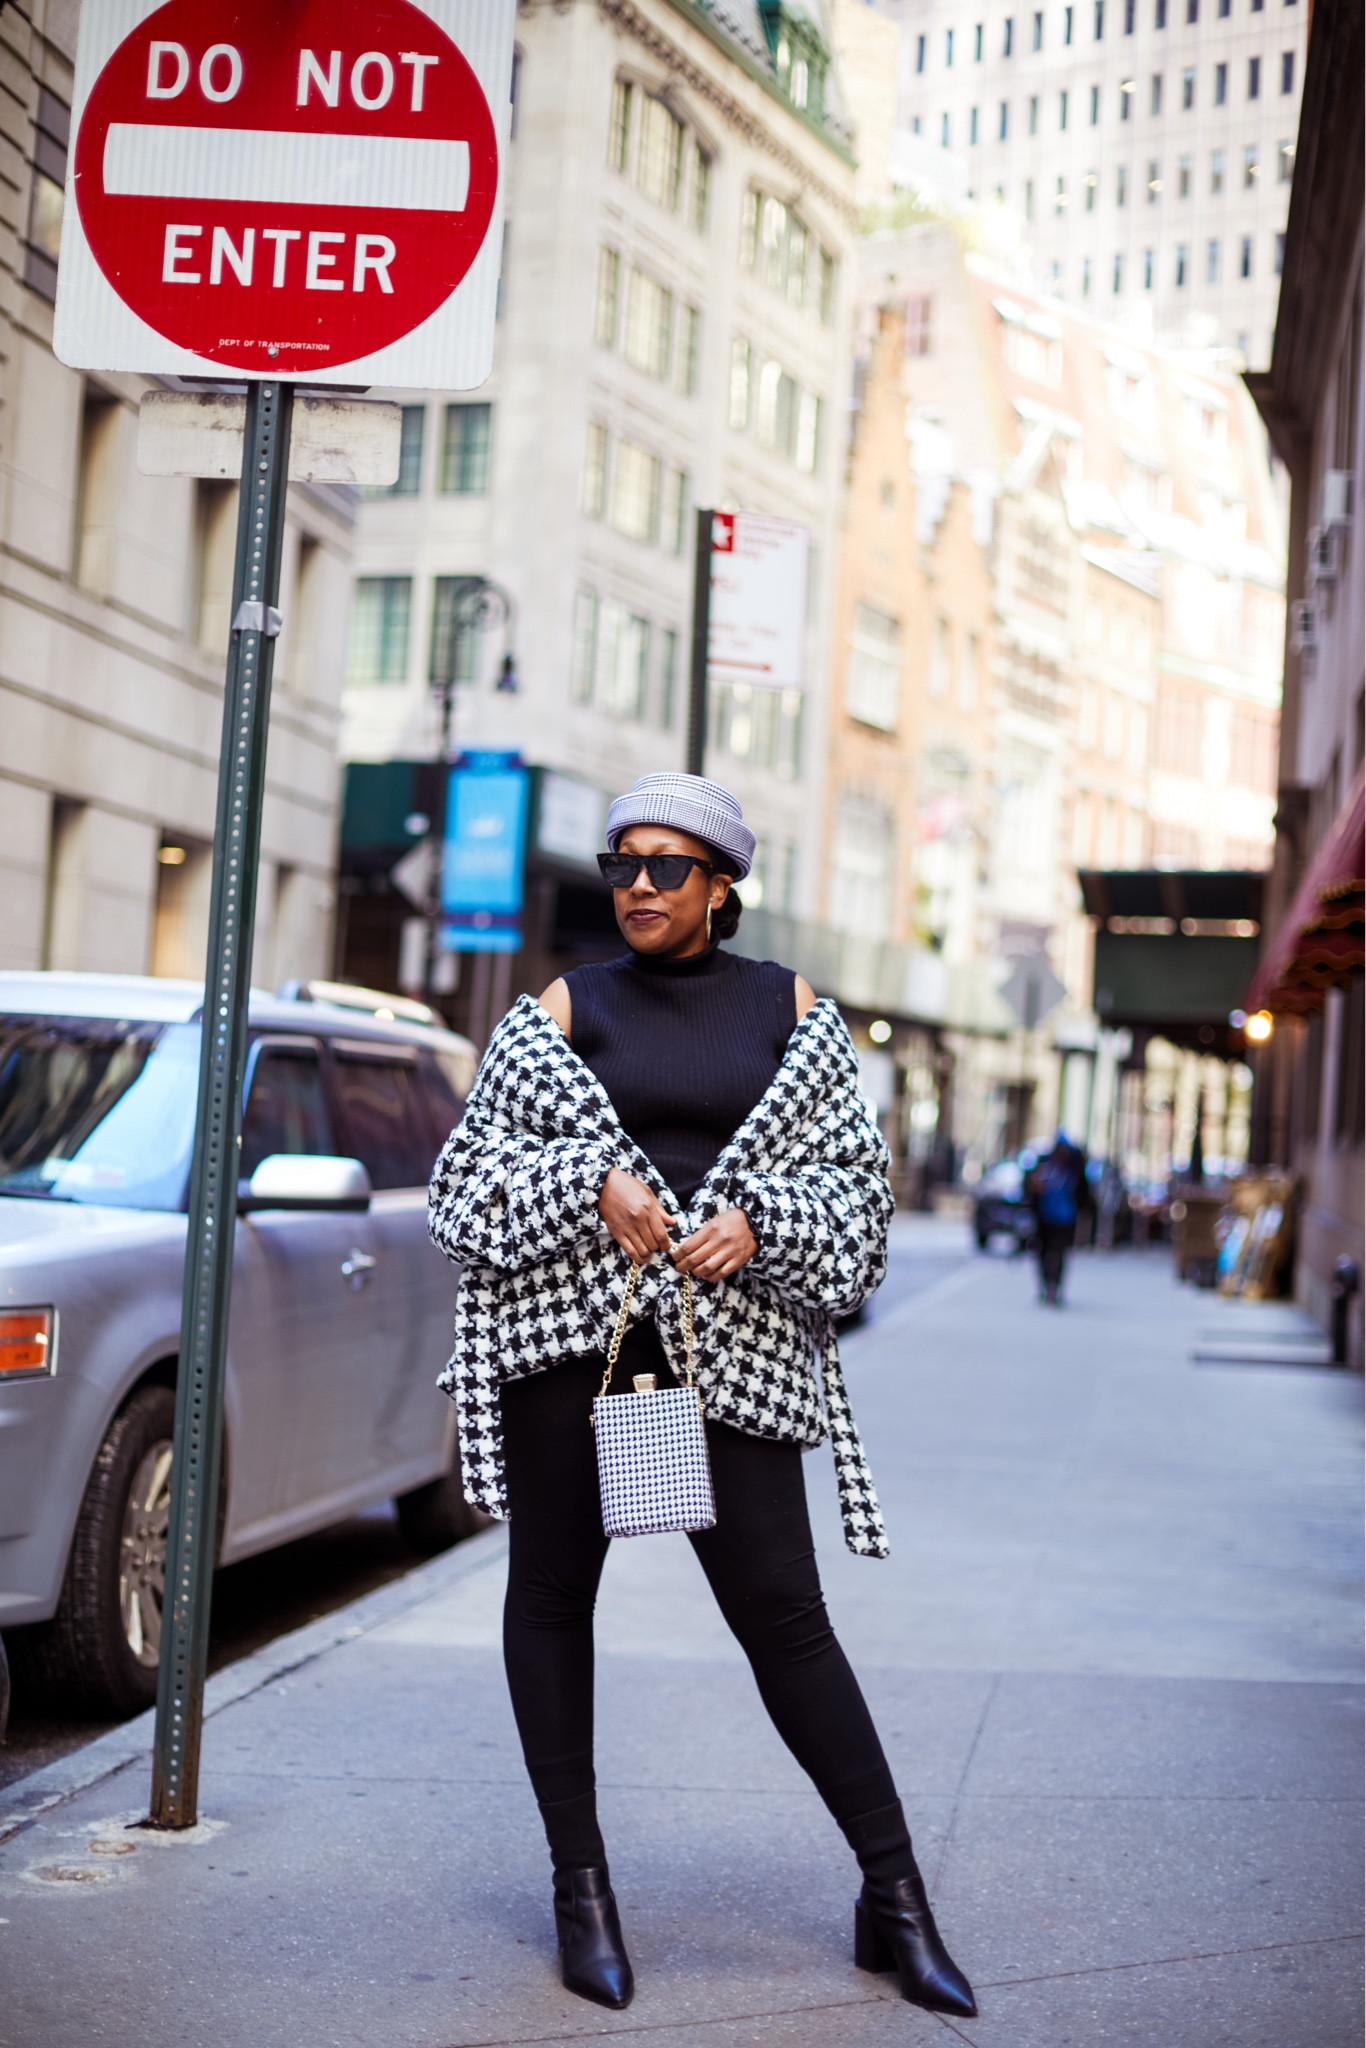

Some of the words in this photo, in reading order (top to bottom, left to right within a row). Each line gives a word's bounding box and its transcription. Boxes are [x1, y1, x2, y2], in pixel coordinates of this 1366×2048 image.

[147, 40, 243, 102] DO
[296, 49, 439, 112] NOT
[162, 224, 397, 294] ENTER
[258, 341, 330, 351] TRANSPORTATION
